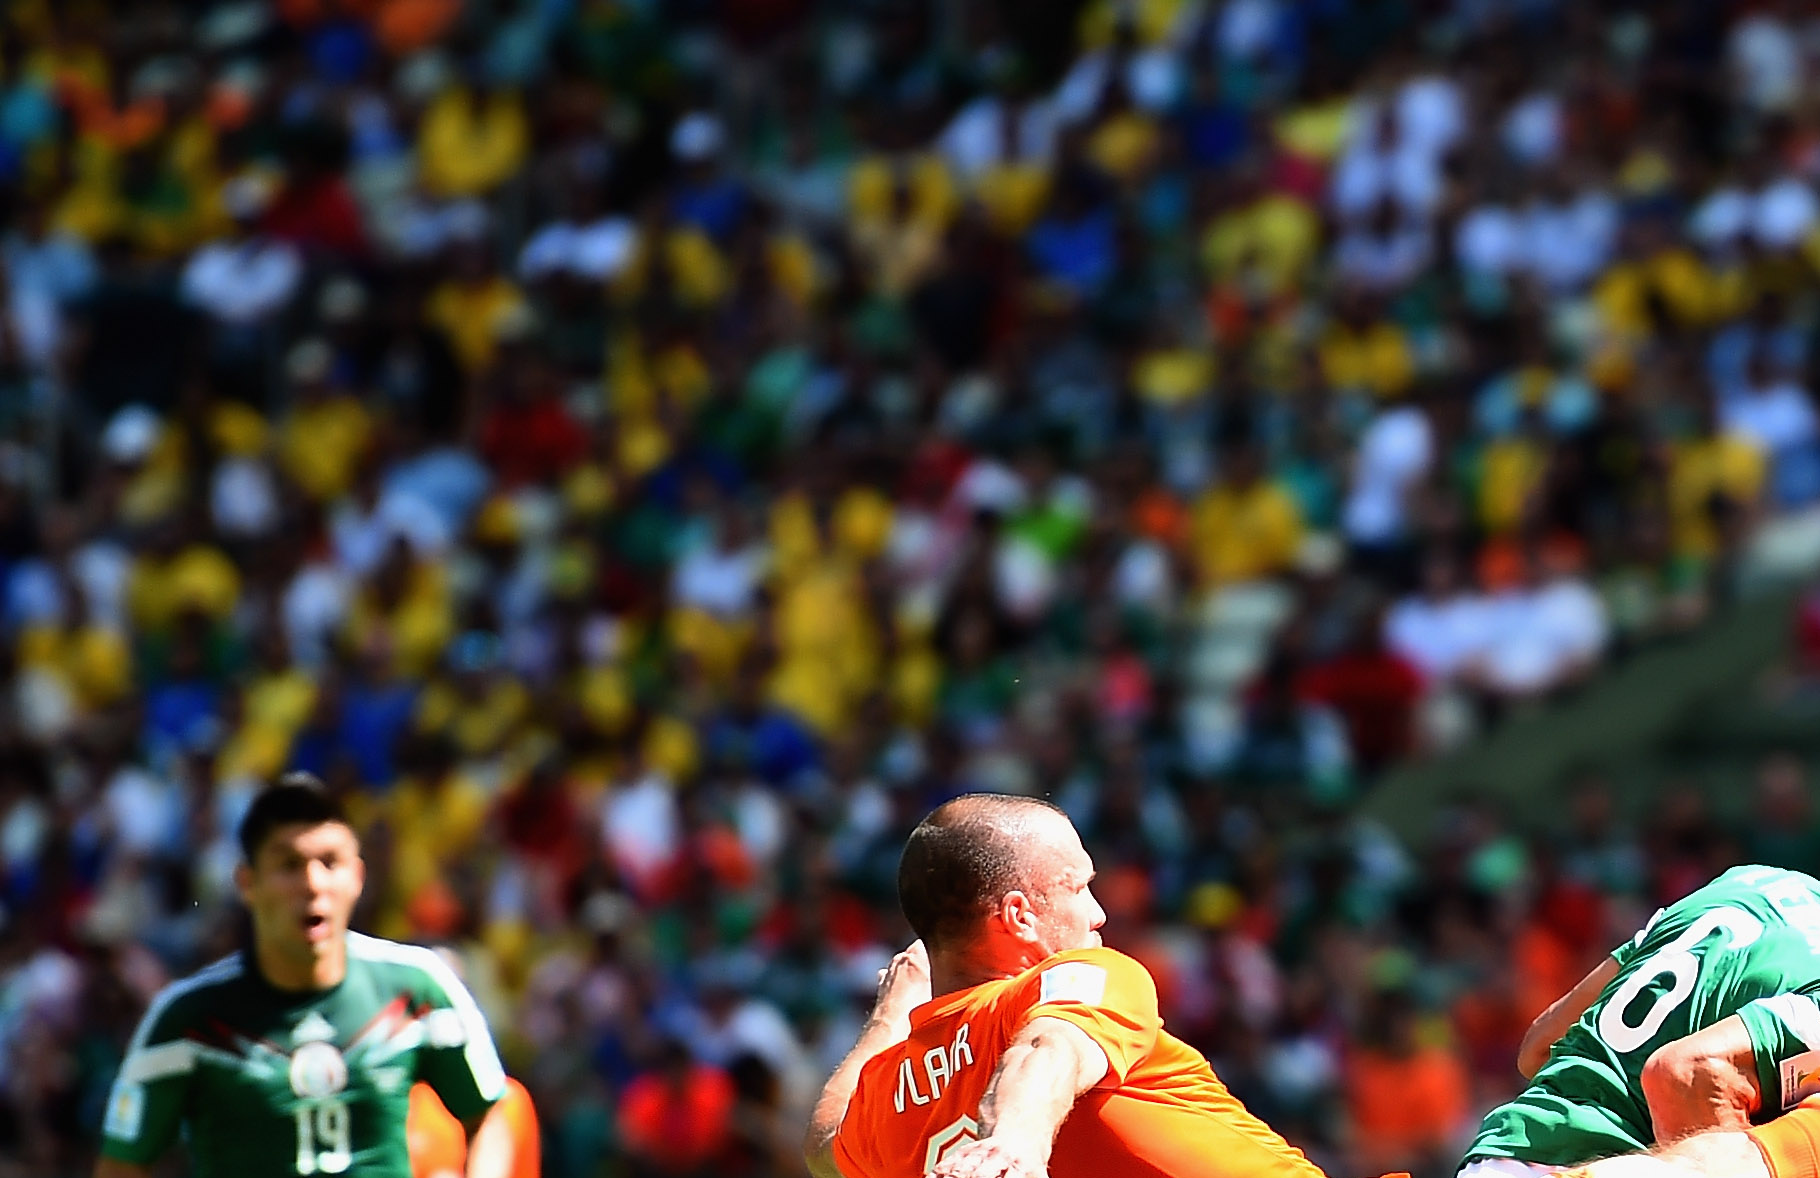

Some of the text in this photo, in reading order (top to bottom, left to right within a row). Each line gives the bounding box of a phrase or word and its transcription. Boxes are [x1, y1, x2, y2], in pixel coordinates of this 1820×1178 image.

[1599, 907, 1765, 1054] 6
[893, 1022, 974, 1114] VLAR
[296, 1101, 352, 1175] 19
